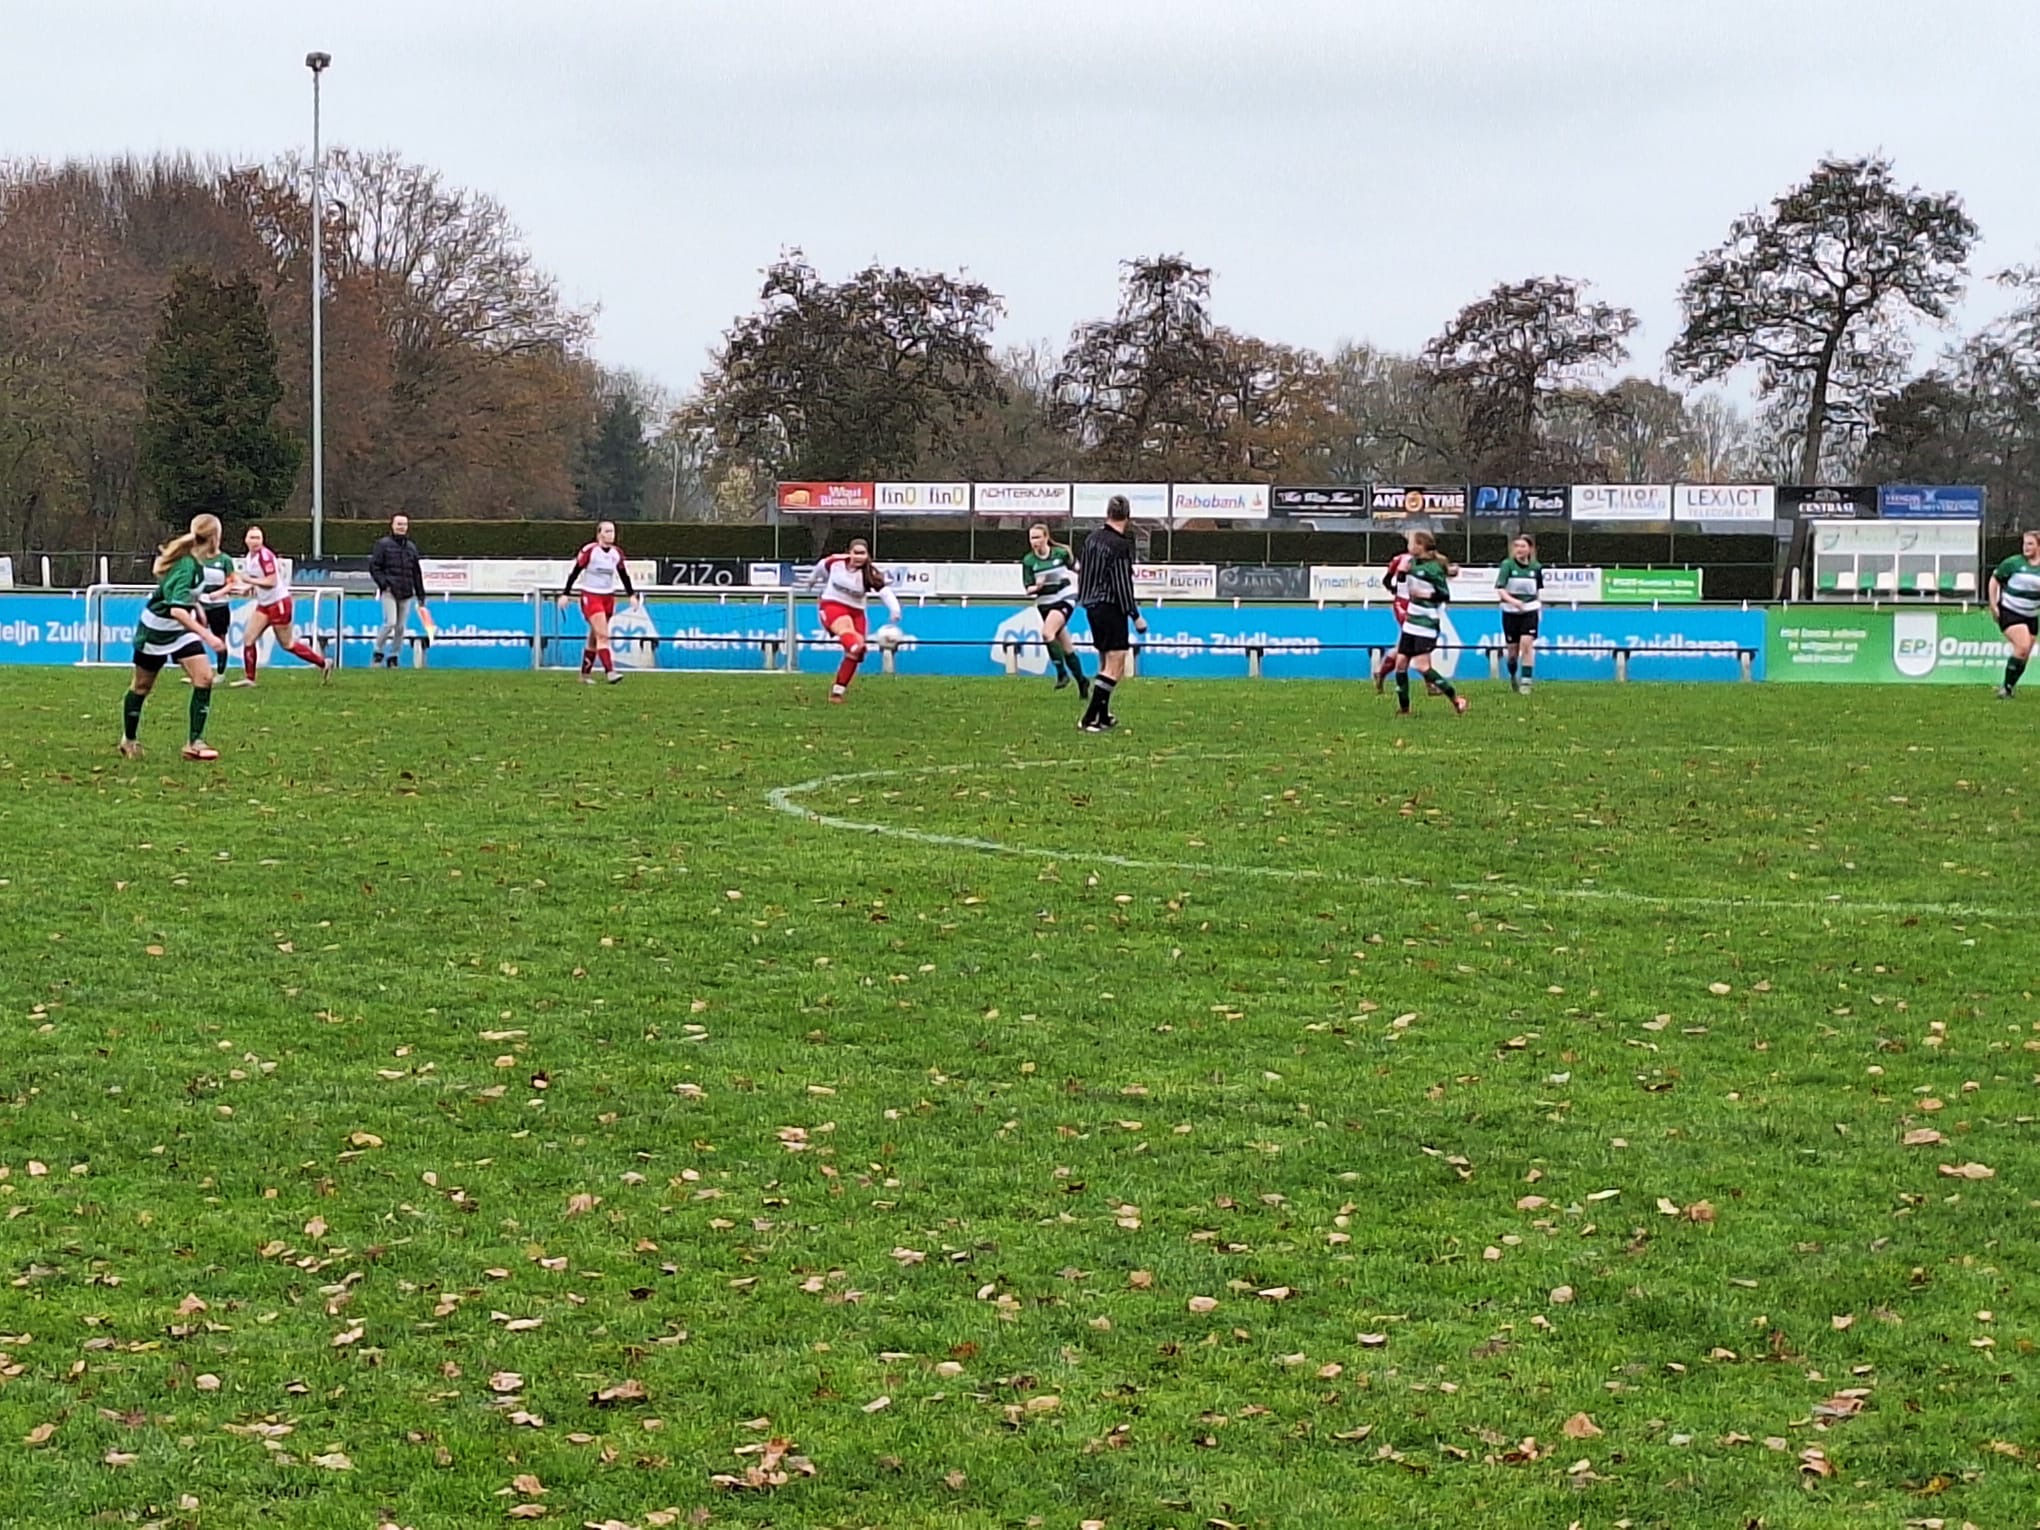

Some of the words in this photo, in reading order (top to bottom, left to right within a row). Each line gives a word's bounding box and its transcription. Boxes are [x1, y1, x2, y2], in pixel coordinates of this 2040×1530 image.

[981, 487, 1065, 498] ACHTERKAMP
[1175, 493, 1246, 509] Rabobank
[1687, 488, 1762, 506] LEXACT
[671, 563, 733, 586] ZiZo
[0, 620, 39, 646] eijn
[45, 621, 137, 642] Zuidlare
[673, 628, 741, 650] Albert
[1145, 631, 1204, 660] Heijn
[1209, 632, 1320, 655] Zuidlaren
[1556, 633, 1617, 662] Heijn
[1624, 635, 1740, 659] Zuidlaren
